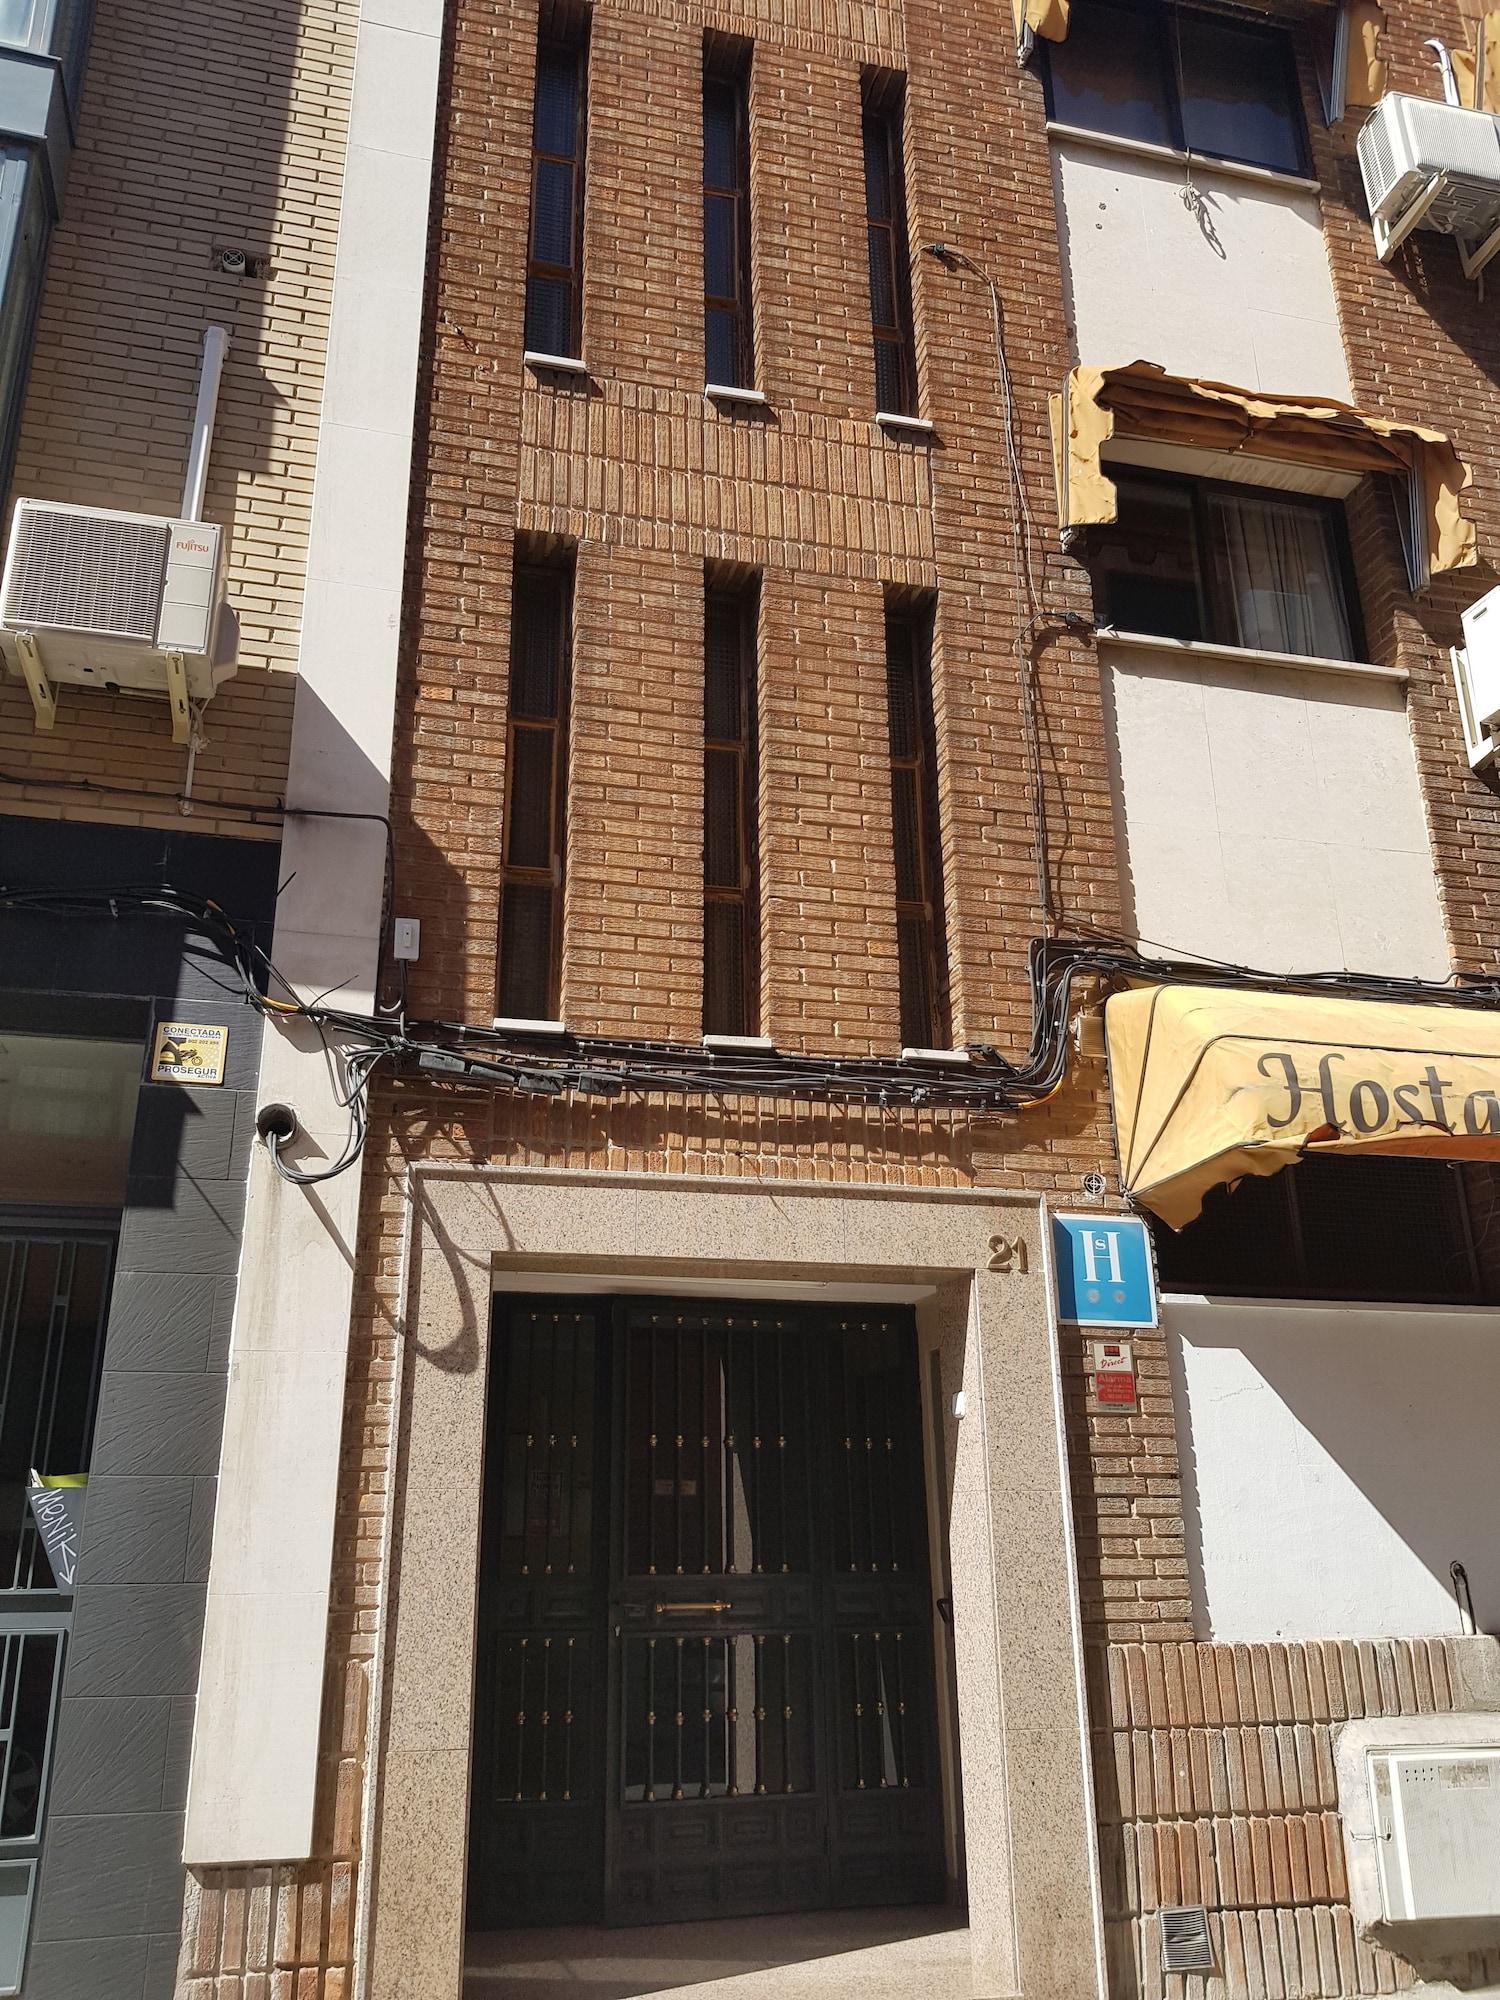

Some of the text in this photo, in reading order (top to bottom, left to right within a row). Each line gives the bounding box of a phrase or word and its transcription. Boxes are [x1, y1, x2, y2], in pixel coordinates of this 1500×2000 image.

[176, 540, 209, 552] FUJITSU
[163, 1026, 221, 1036] CONECTADA
[157, 1065, 217, 1075] PROSEGUR
[987, 1234, 1029, 1274] 21
[1079, 1230, 1127, 1283] H
[1100, 1356, 1128, 1369] Direct
[1098, 1373, 1132, 1383] Alarma
